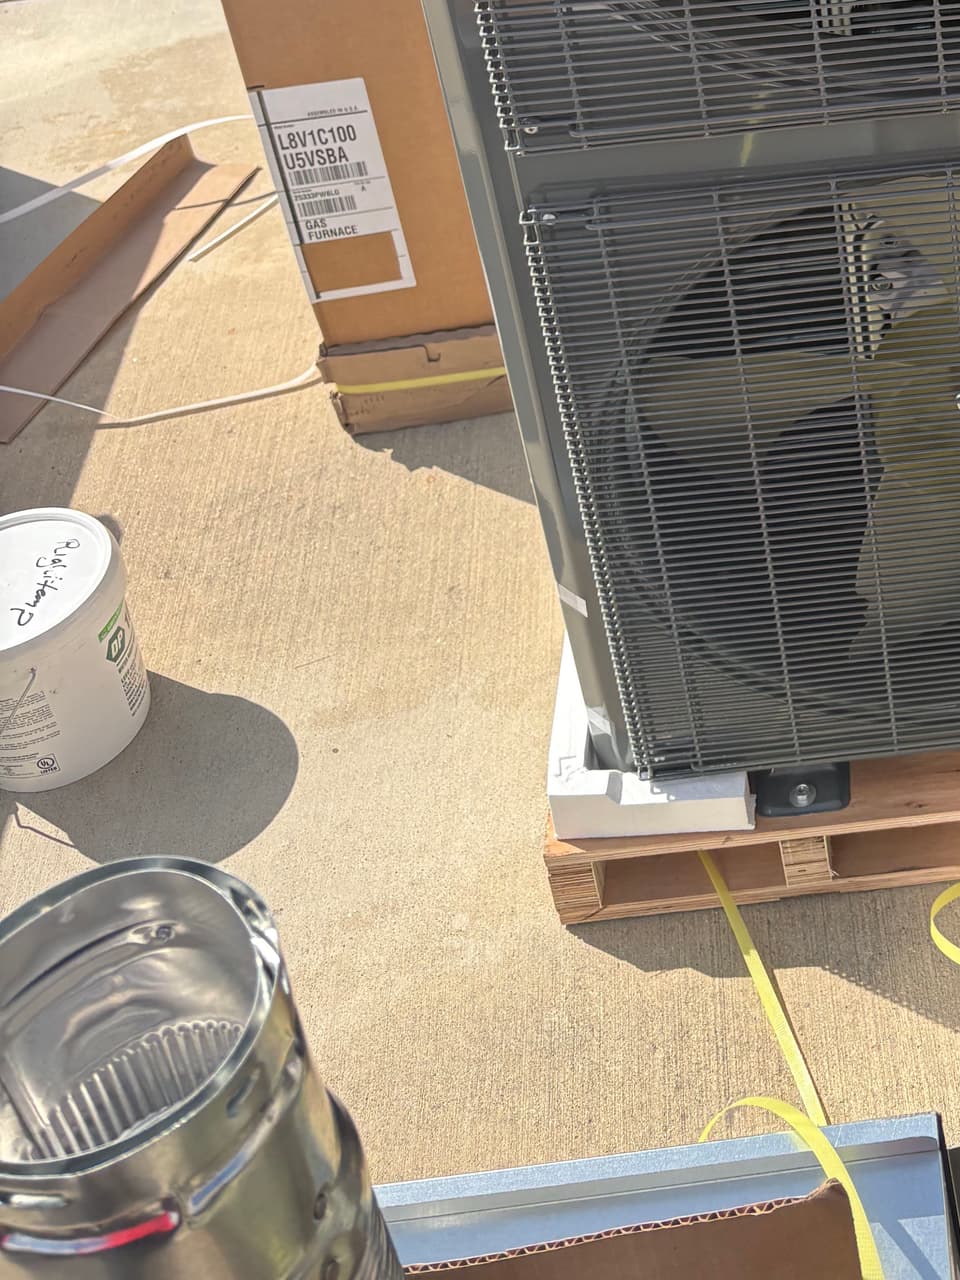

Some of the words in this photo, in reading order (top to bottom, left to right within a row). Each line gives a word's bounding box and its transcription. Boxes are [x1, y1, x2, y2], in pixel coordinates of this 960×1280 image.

[278, 124, 357, 150] L8V1C100
[283, 146, 350, 170] U5VSBA
[305, 217, 328, 231] GAS
[308, 225, 359, 241] FURNACE
